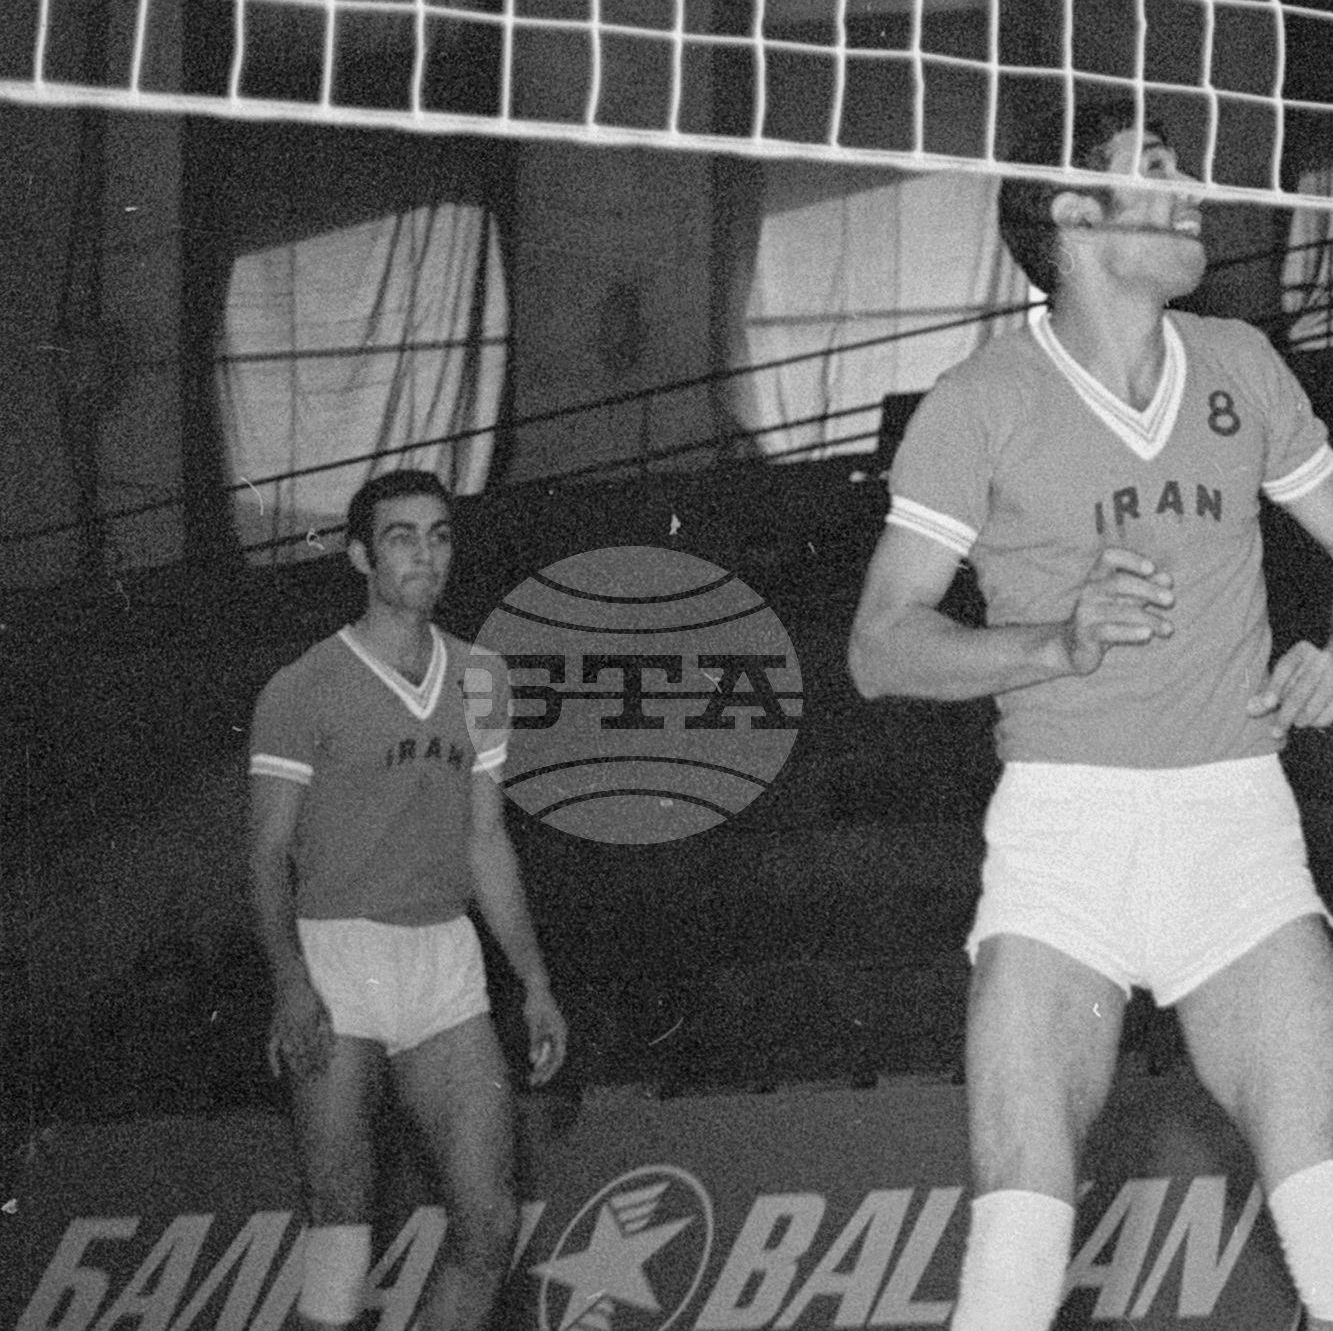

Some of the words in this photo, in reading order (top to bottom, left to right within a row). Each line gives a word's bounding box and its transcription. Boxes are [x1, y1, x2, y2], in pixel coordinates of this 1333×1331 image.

[1207, 390, 1241, 436] 8
[1094, 480, 1222, 535] IRAN
[696, 1175, 1263, 1330] BALAN
